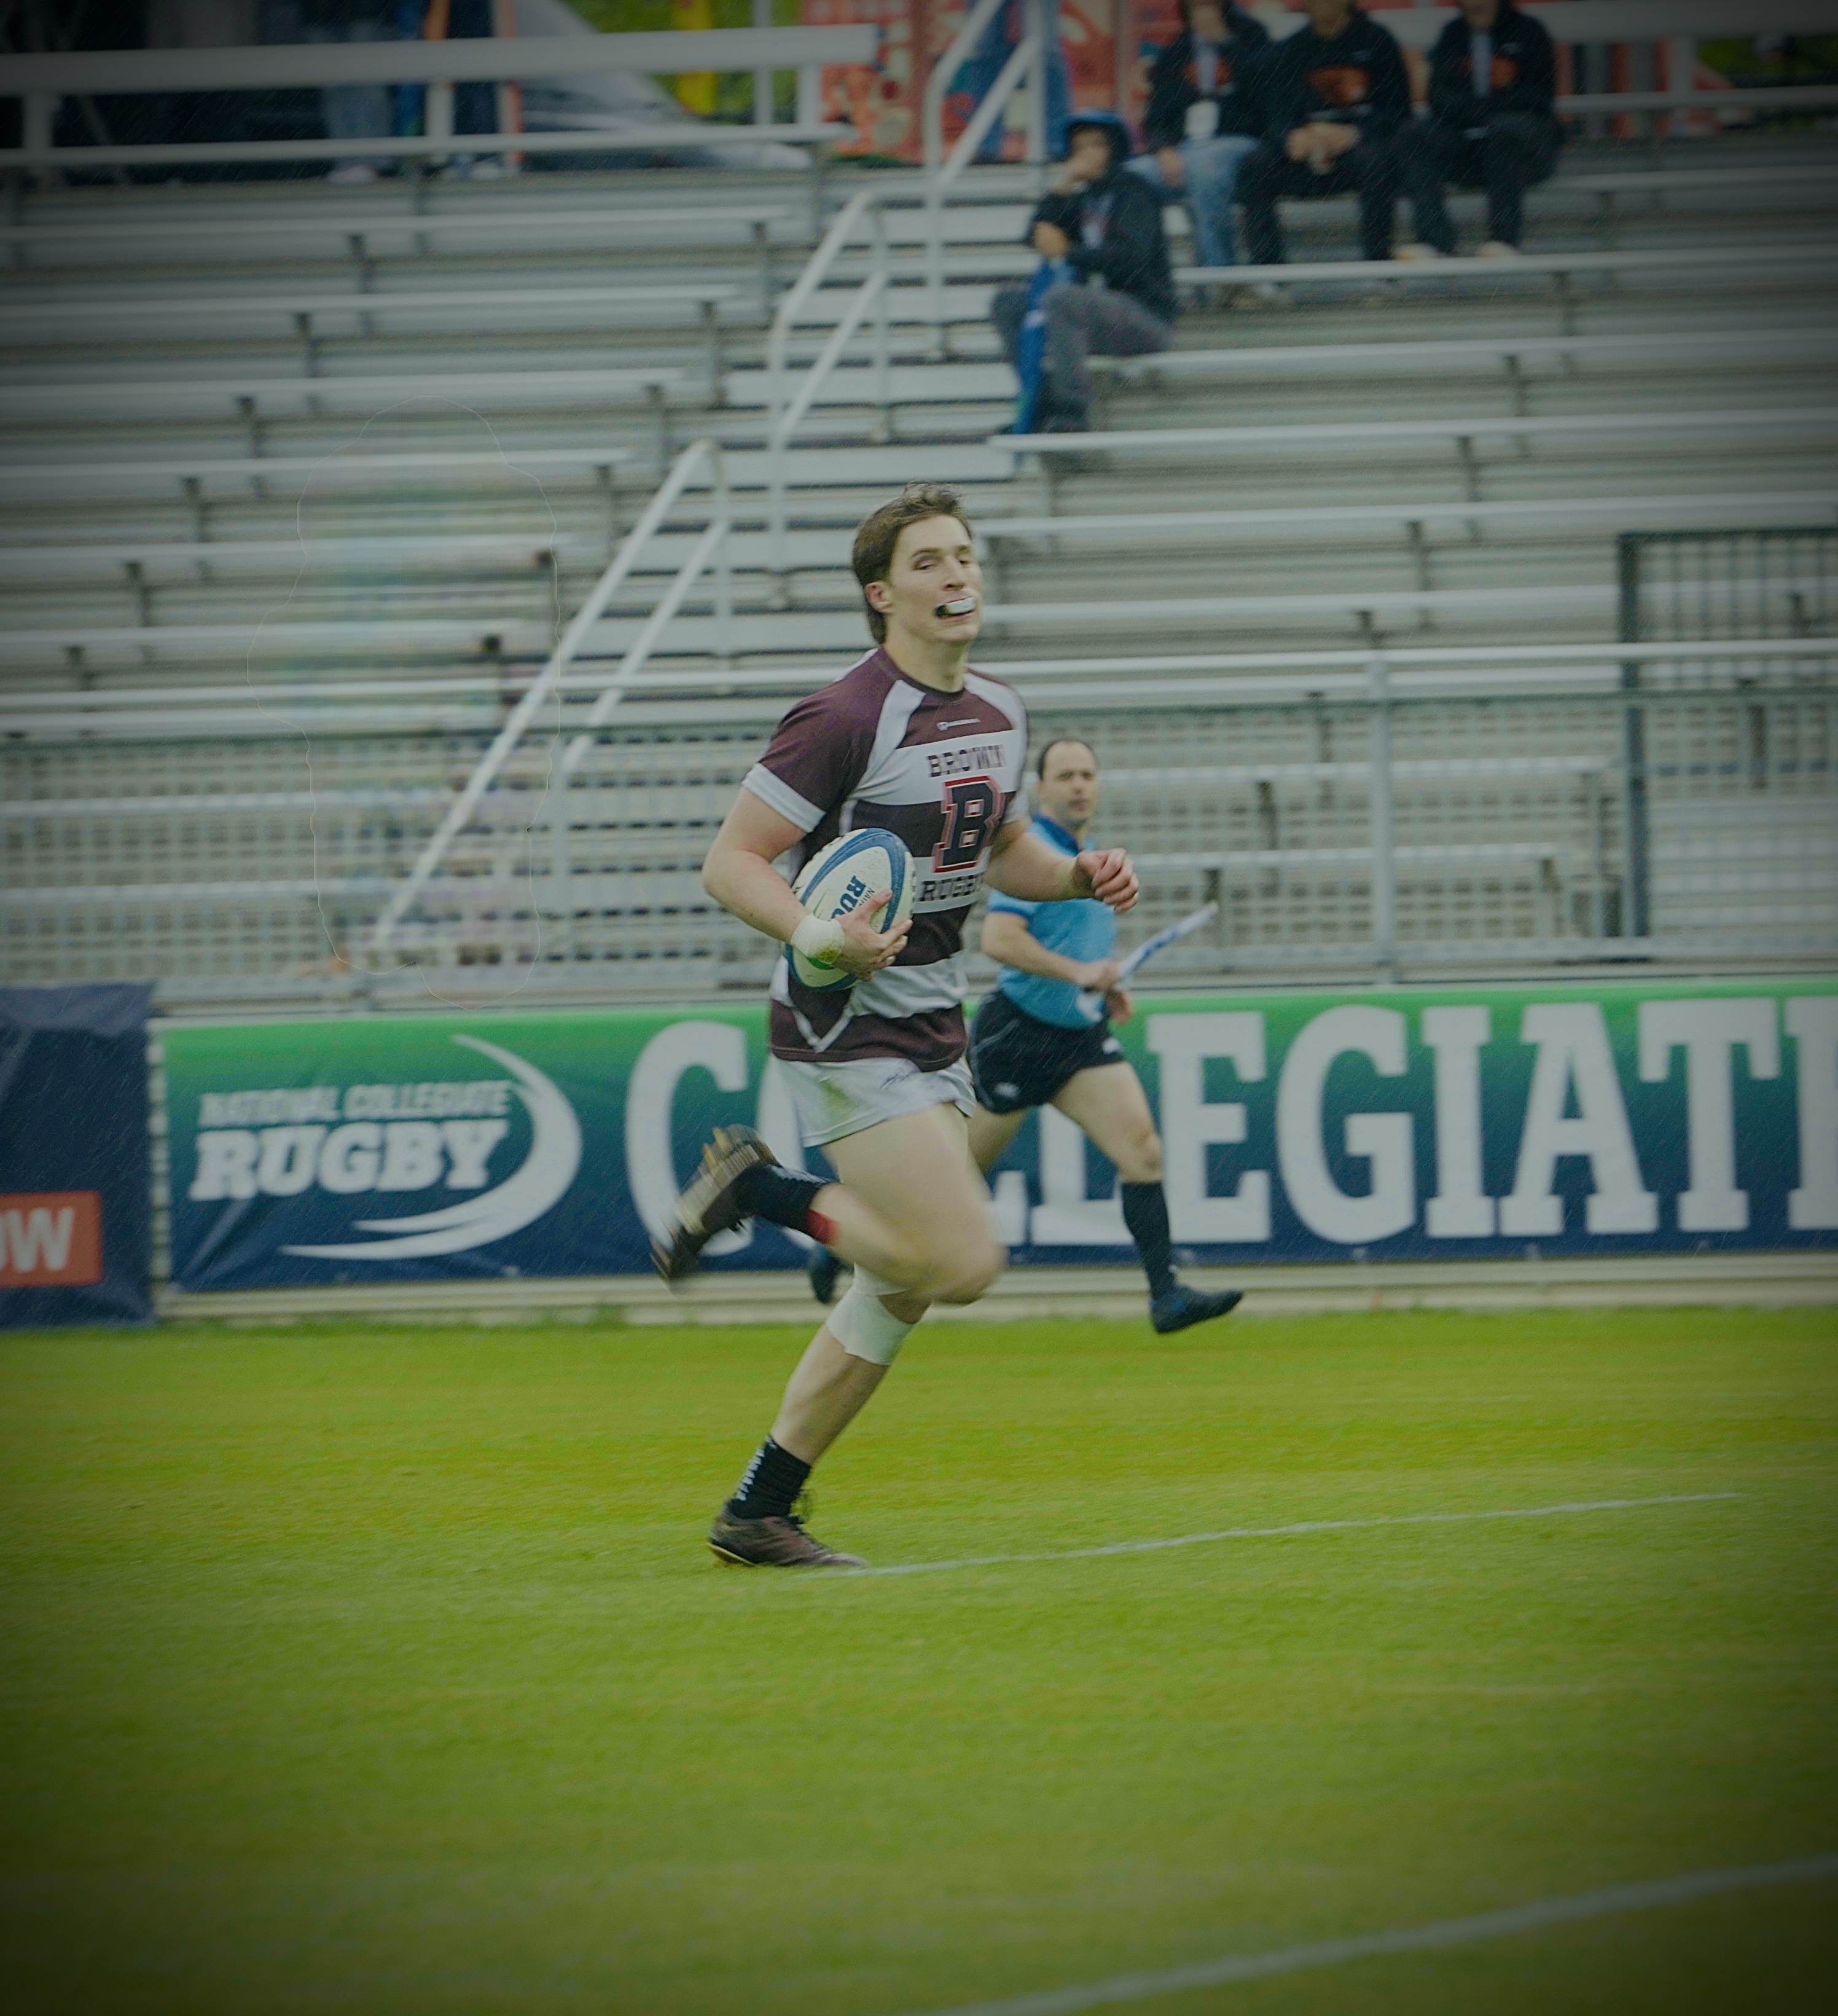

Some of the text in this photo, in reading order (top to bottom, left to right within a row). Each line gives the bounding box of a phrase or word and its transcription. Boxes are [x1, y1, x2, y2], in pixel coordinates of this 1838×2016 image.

[927, 745, 1004, 777] BROWN
[931, 775, 1006, 873] B
[917, 873, 983, 901] RUGB
[189, 1118, 510, 1202] RUGBY
[0, 1206, 75, 1272] W
